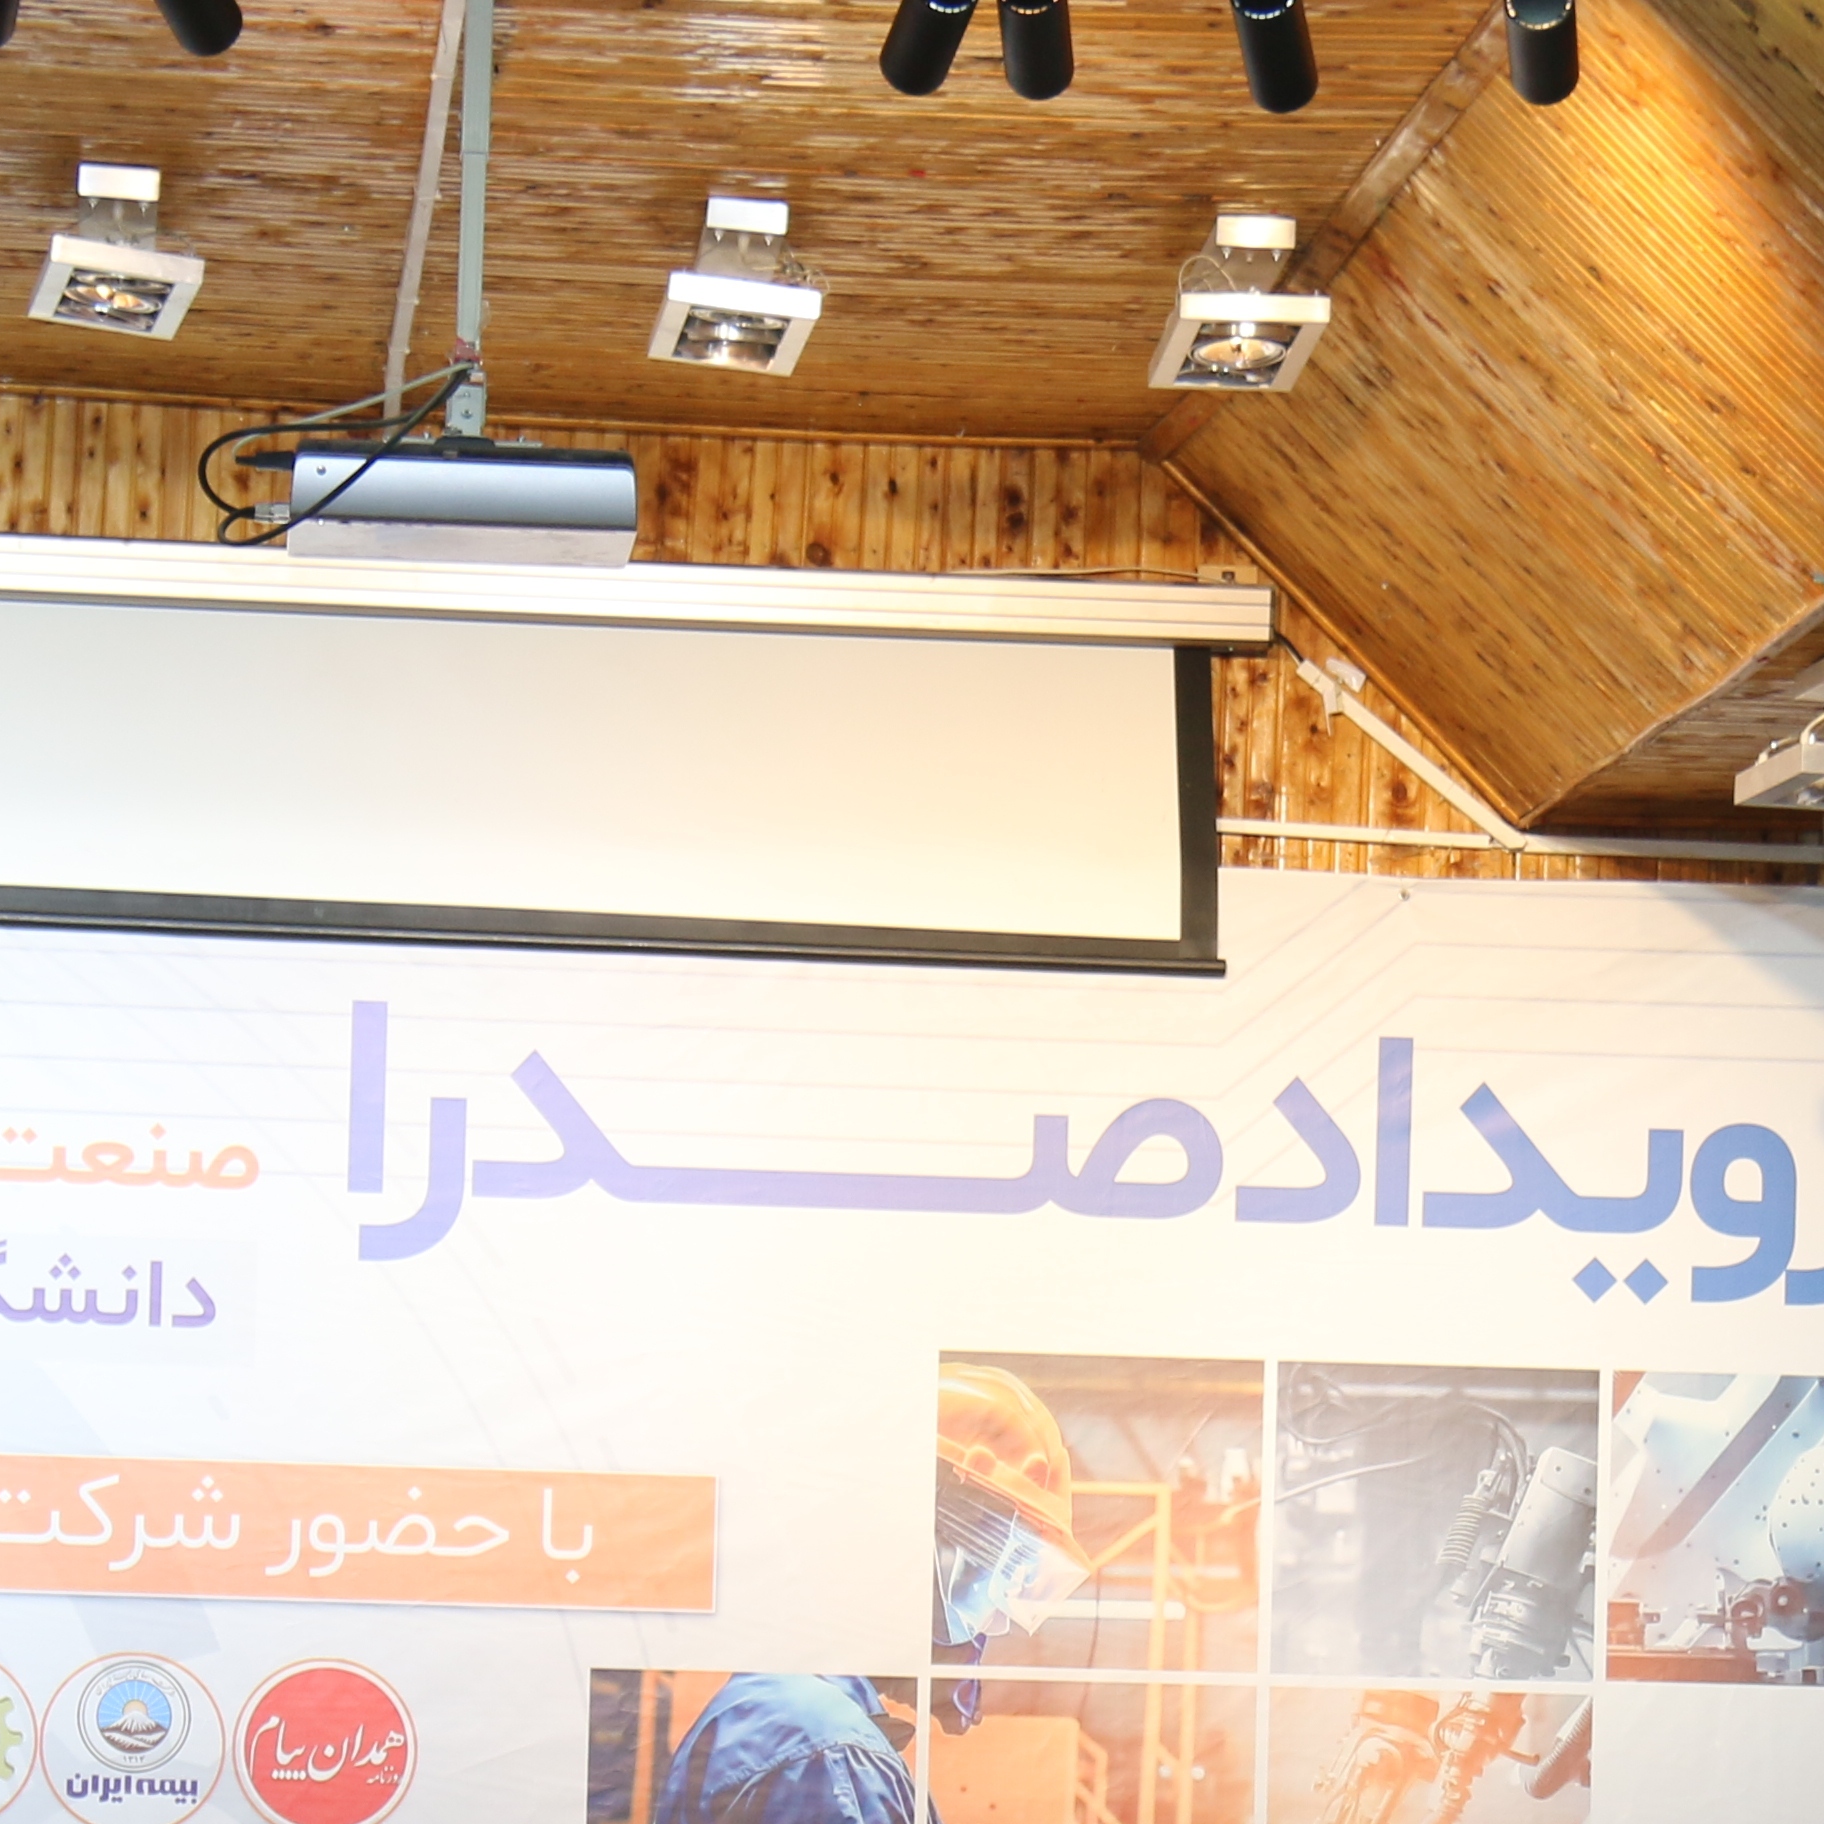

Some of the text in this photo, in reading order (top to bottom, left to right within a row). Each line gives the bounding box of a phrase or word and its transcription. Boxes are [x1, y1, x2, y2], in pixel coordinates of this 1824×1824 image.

[346, 1000, 1223, 1262] صدرا
[266, 1481, 511, 1578] حضور
[540, 1486, 596, 1586] با
[65, 1772, 199, 1805] بیمه ایران
[249, 1714, 406, 1783] همدان پیام
